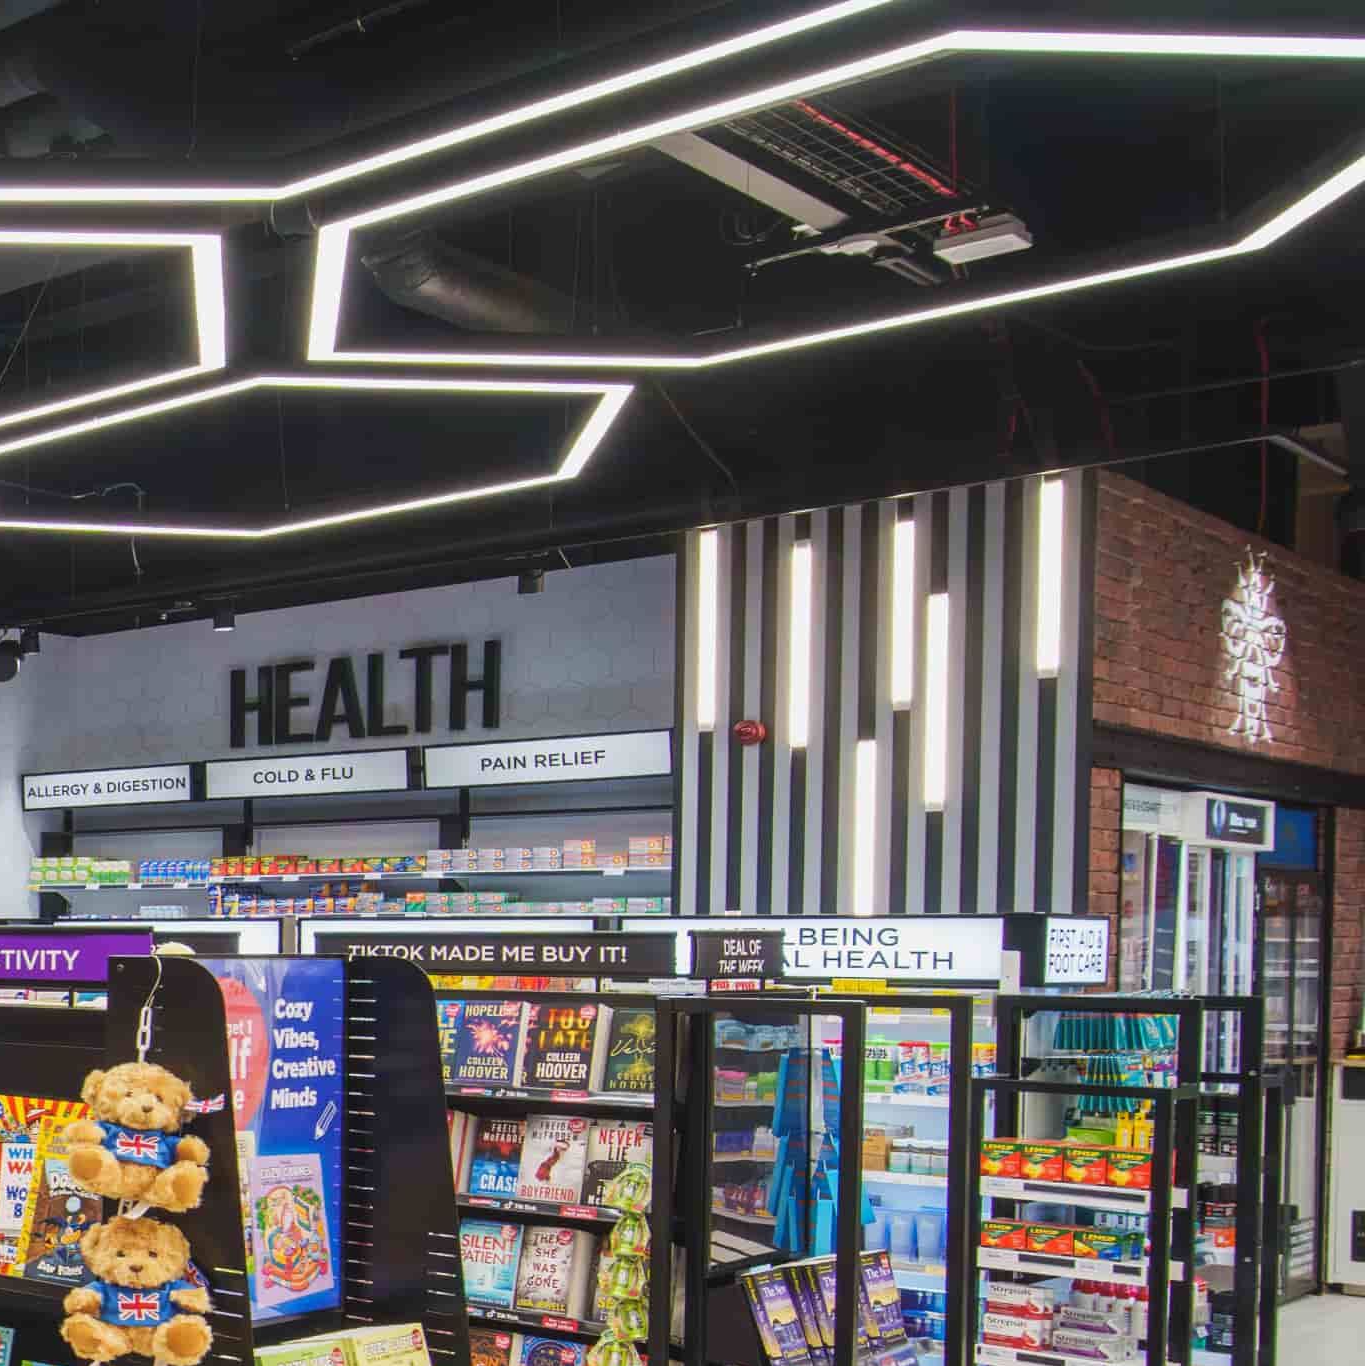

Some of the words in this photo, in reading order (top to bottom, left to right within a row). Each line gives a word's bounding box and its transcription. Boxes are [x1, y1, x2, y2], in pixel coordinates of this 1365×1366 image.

[230, 640, 500, 747] HEALTH
[480, 755, 529, 772] PAIN
[534, 751, 605, 768] RELIEF
[252, 770, 300, 785] COLD
[304, 769, 316, 782] &
[320, 766, 354, 781] FLU
[26, 781, 88, 797] ALLERGY
[92, 781, 103, 793] &
[107, 777, 186, 793] DIGESTION
[784, 928, 899, 947] BEING
[1050, 929, 1077, 947] FIRST
[1080, 931, 1095, 947] AID
[349, 945, 425, 962] TIKTOK
[431, 945, 494, 962] MADE
[502, 945, 534, 962] ME
[542, 945, 591, 963] BUY
[599, 945, 628, 963] IT!
[724, 939, 746, 956] DEAL
[748, 939, 762, 956] OF
[718, 960, 740, 974] THE
[823, 951, 954, 970] HEALTH
[1049, 955, 1075, 975] FOOT
[1077, 954, 1102, 974] CARE
[274, 999, 313, 1020] Cozy
[465, 1004, 518, 1018] HOPEL
[274, 1027, 319, 1050] Vibes,
[466, 1057, 504, 1067] COLLEEN
[545, 1052, 581, 1063] COLLEEN
[272, 1058, 336, 1081] Creative
[458, 1066, 509, 1080] HOOVER
[536, 1063, 587, 1080] HOOVER
[617, 1072, 654, 1081] COLLEE
[271, 1087, 317, 1109] Minds
[598, 1127, 644, 1147] NEVER
[608, 1146, 628, 1162] LIE
[983, 1143, 1015, 1152] LEMSIP
[1024, 1145, 1056, 1155] LEMSIP
[1067, 1149, 1101, 1158] LEMSIP
[1111, 1152, 1146, 1162] LEMSIP
[520, 1185, 575, 1201] BOYFRIEND
[984, 1222, 1014, 1231] LEMSIP
[1030, 1226, 1060, 1236] LEMSIP
[462, 1233, 516, 1252] SILENT
[1082, 1232, 1118, 1243] LEMSIP
[460, 1249, 514, 1265] PATIENT
[535, 1247, 558, 1258] SHE
[532, 1263, 558, 1274] WAS
[526, 1276, 559, 1289] GONE
[990, 1284, 1033, 1297] Strepsils
[986, 1315, 1028, 1330] Strepsils
[1062, 1308, 1105, 1322] Strepsils
[1055, 1333, 1097, 1347] Strepsils
